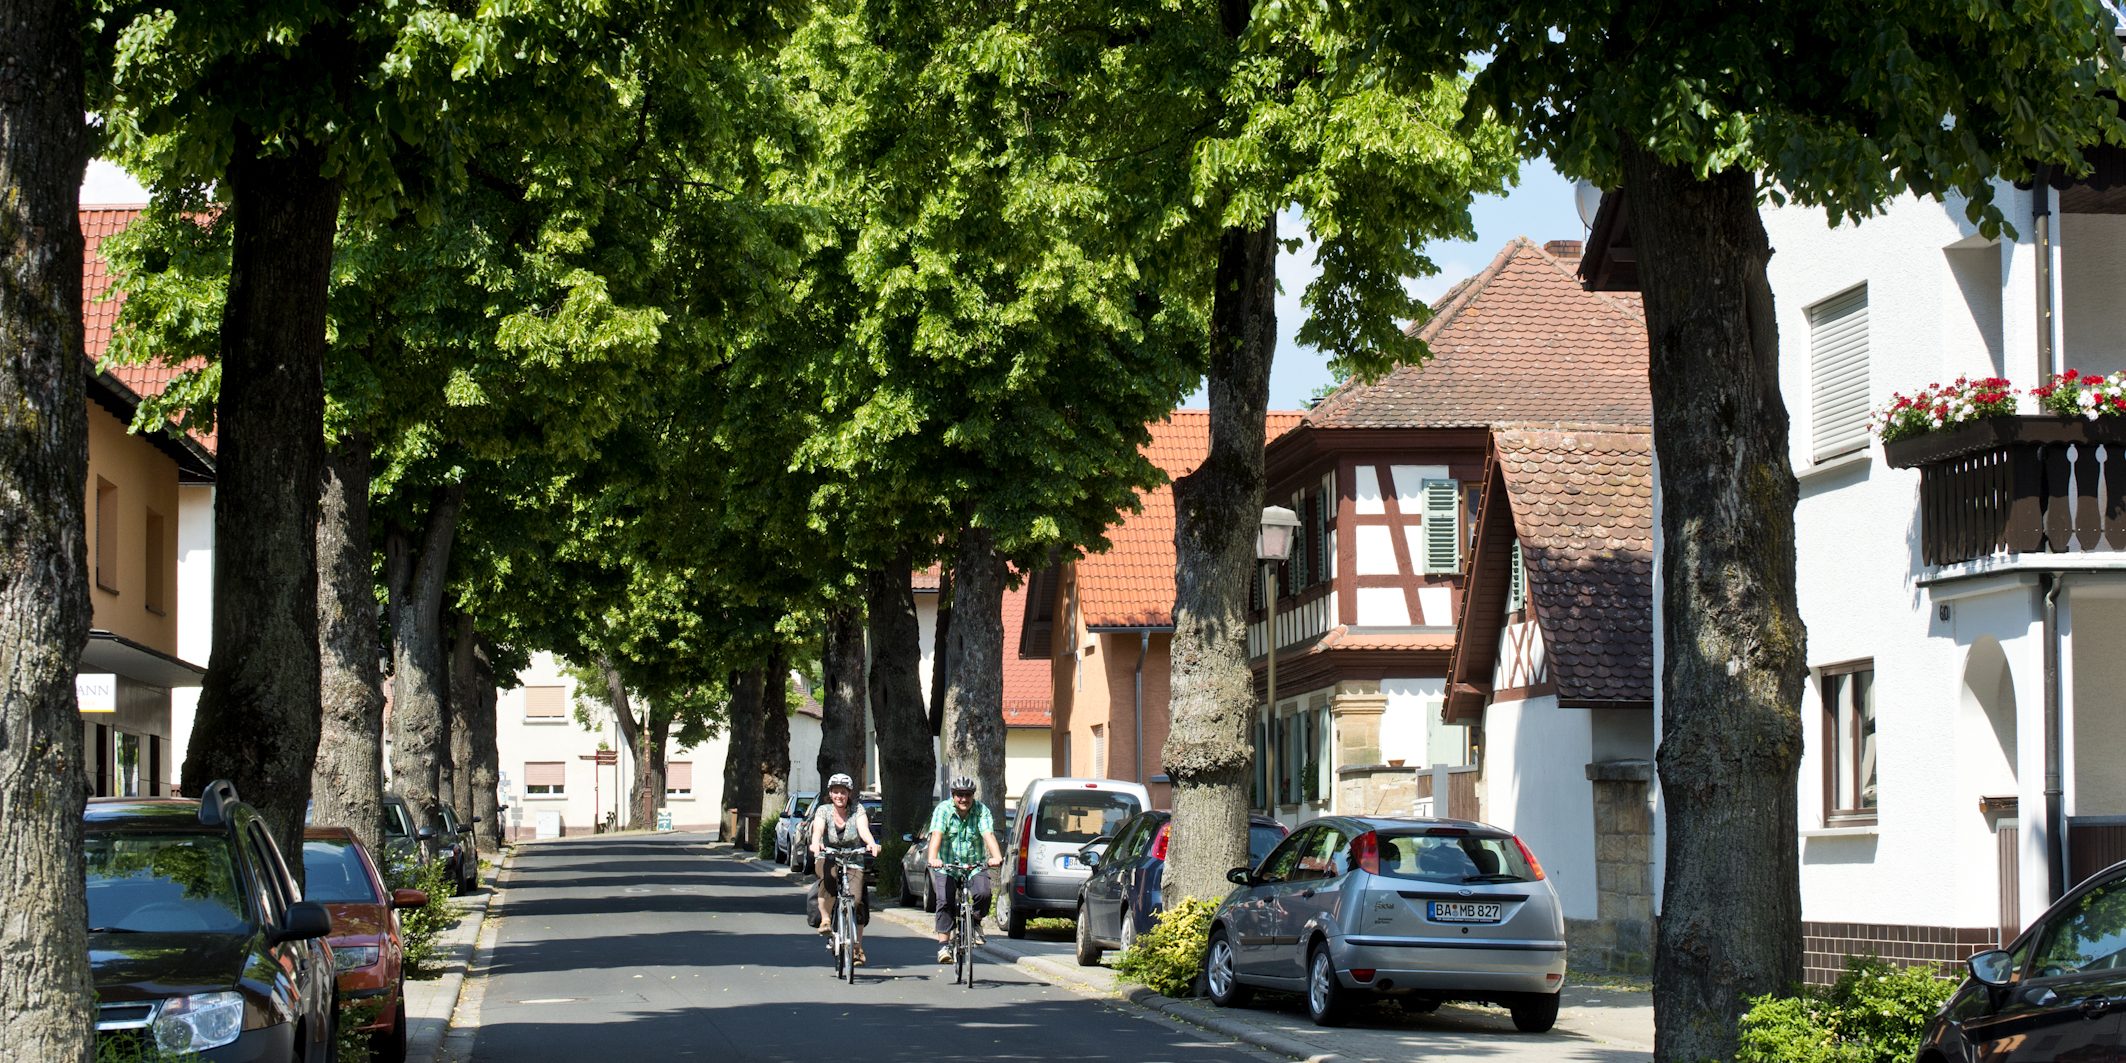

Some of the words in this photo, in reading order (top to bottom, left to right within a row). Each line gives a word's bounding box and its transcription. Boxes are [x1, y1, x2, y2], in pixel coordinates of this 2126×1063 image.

[1436, 904, 1451, 916] BA
[1460, 905, 1475, 917] MB
[1477, 905, 1499, 917] 827
